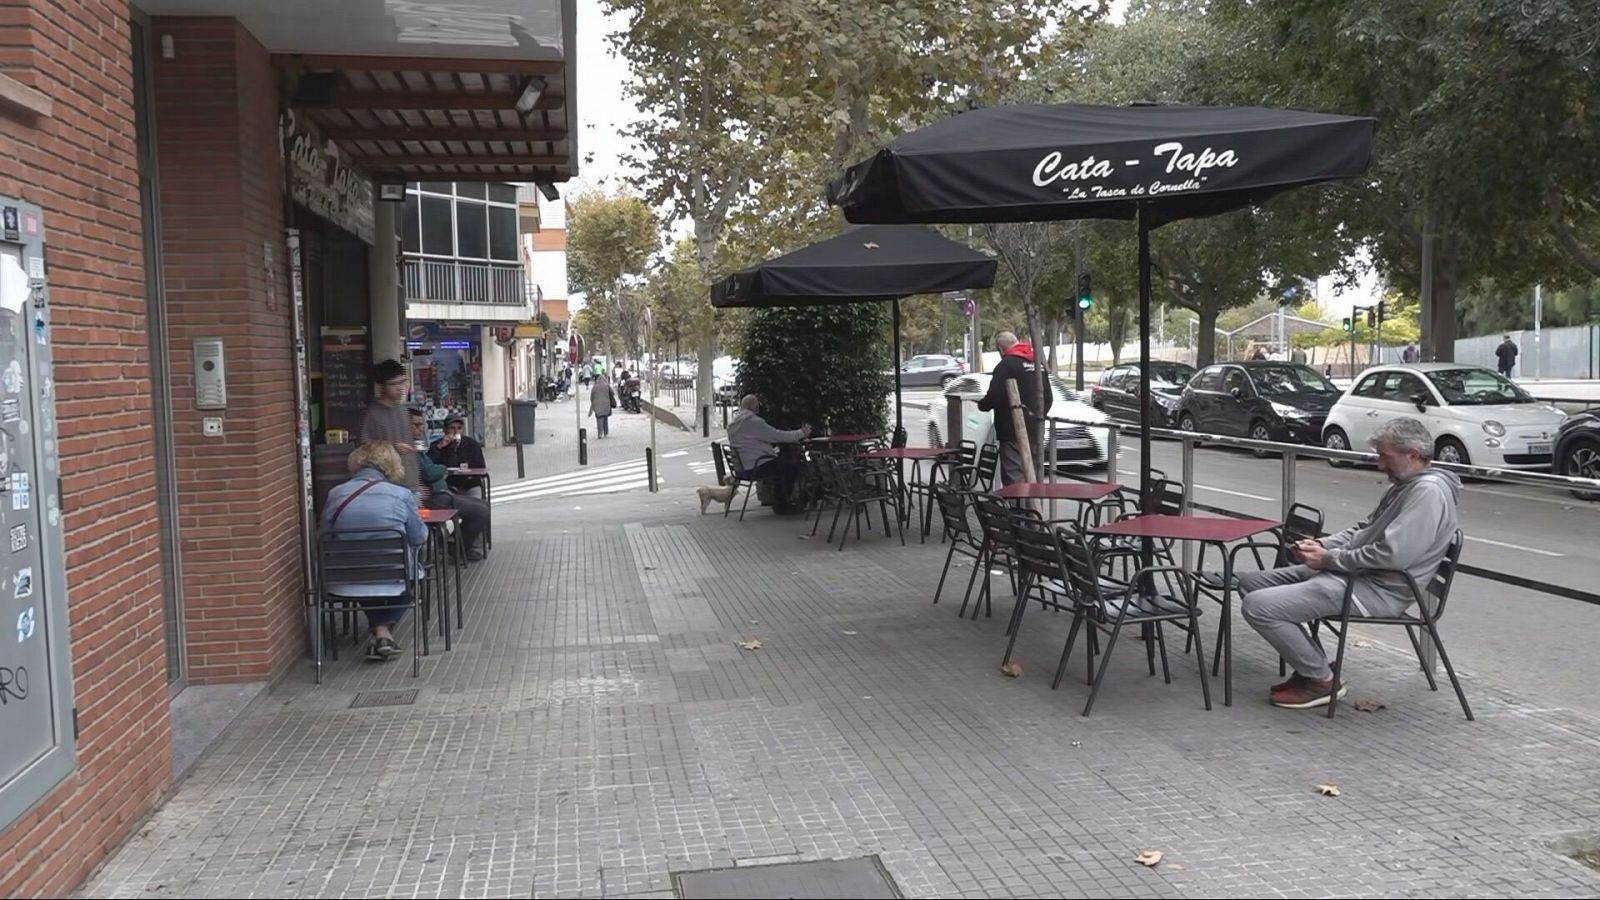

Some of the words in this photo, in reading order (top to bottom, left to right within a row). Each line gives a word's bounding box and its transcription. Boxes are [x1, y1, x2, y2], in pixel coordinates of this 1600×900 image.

[1032, 151, 1115, 187] Cata
[1153, 141, 1239, 178] Tapa
[1090, 185, 1127, 198] Tasca
[1130, 183, 1145, 195] de
